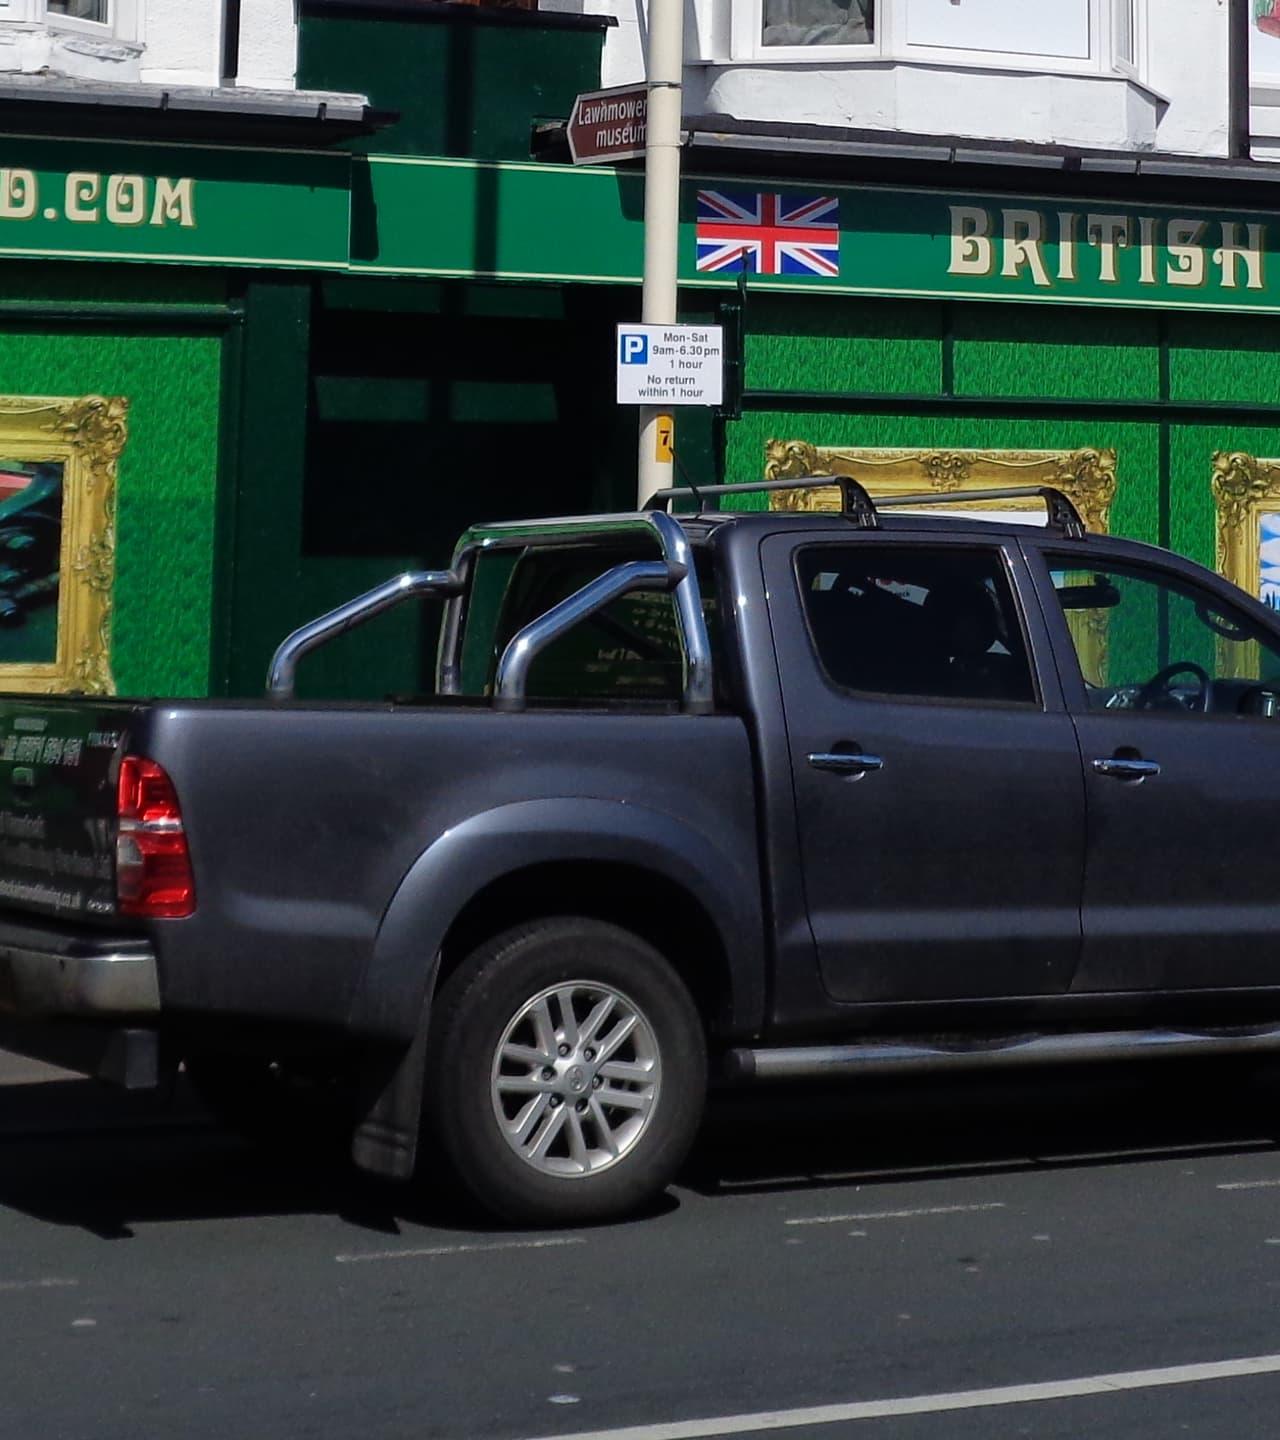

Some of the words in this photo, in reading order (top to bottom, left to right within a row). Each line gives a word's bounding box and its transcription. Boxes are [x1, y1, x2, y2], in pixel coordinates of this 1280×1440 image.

[578, 99, 647, 126] Lawnmower
[946, 204, 1267, 288] BRITISH
[625, 336, 644, 363] P
[678, 359, 704, 369] hour
[647, 375, 662, 385] No
[664, 375, 696, 385] return
[638, 387, 669, 397] within
[680, 387, 704, 397] hour
[659, 430, 670, 446] 7
